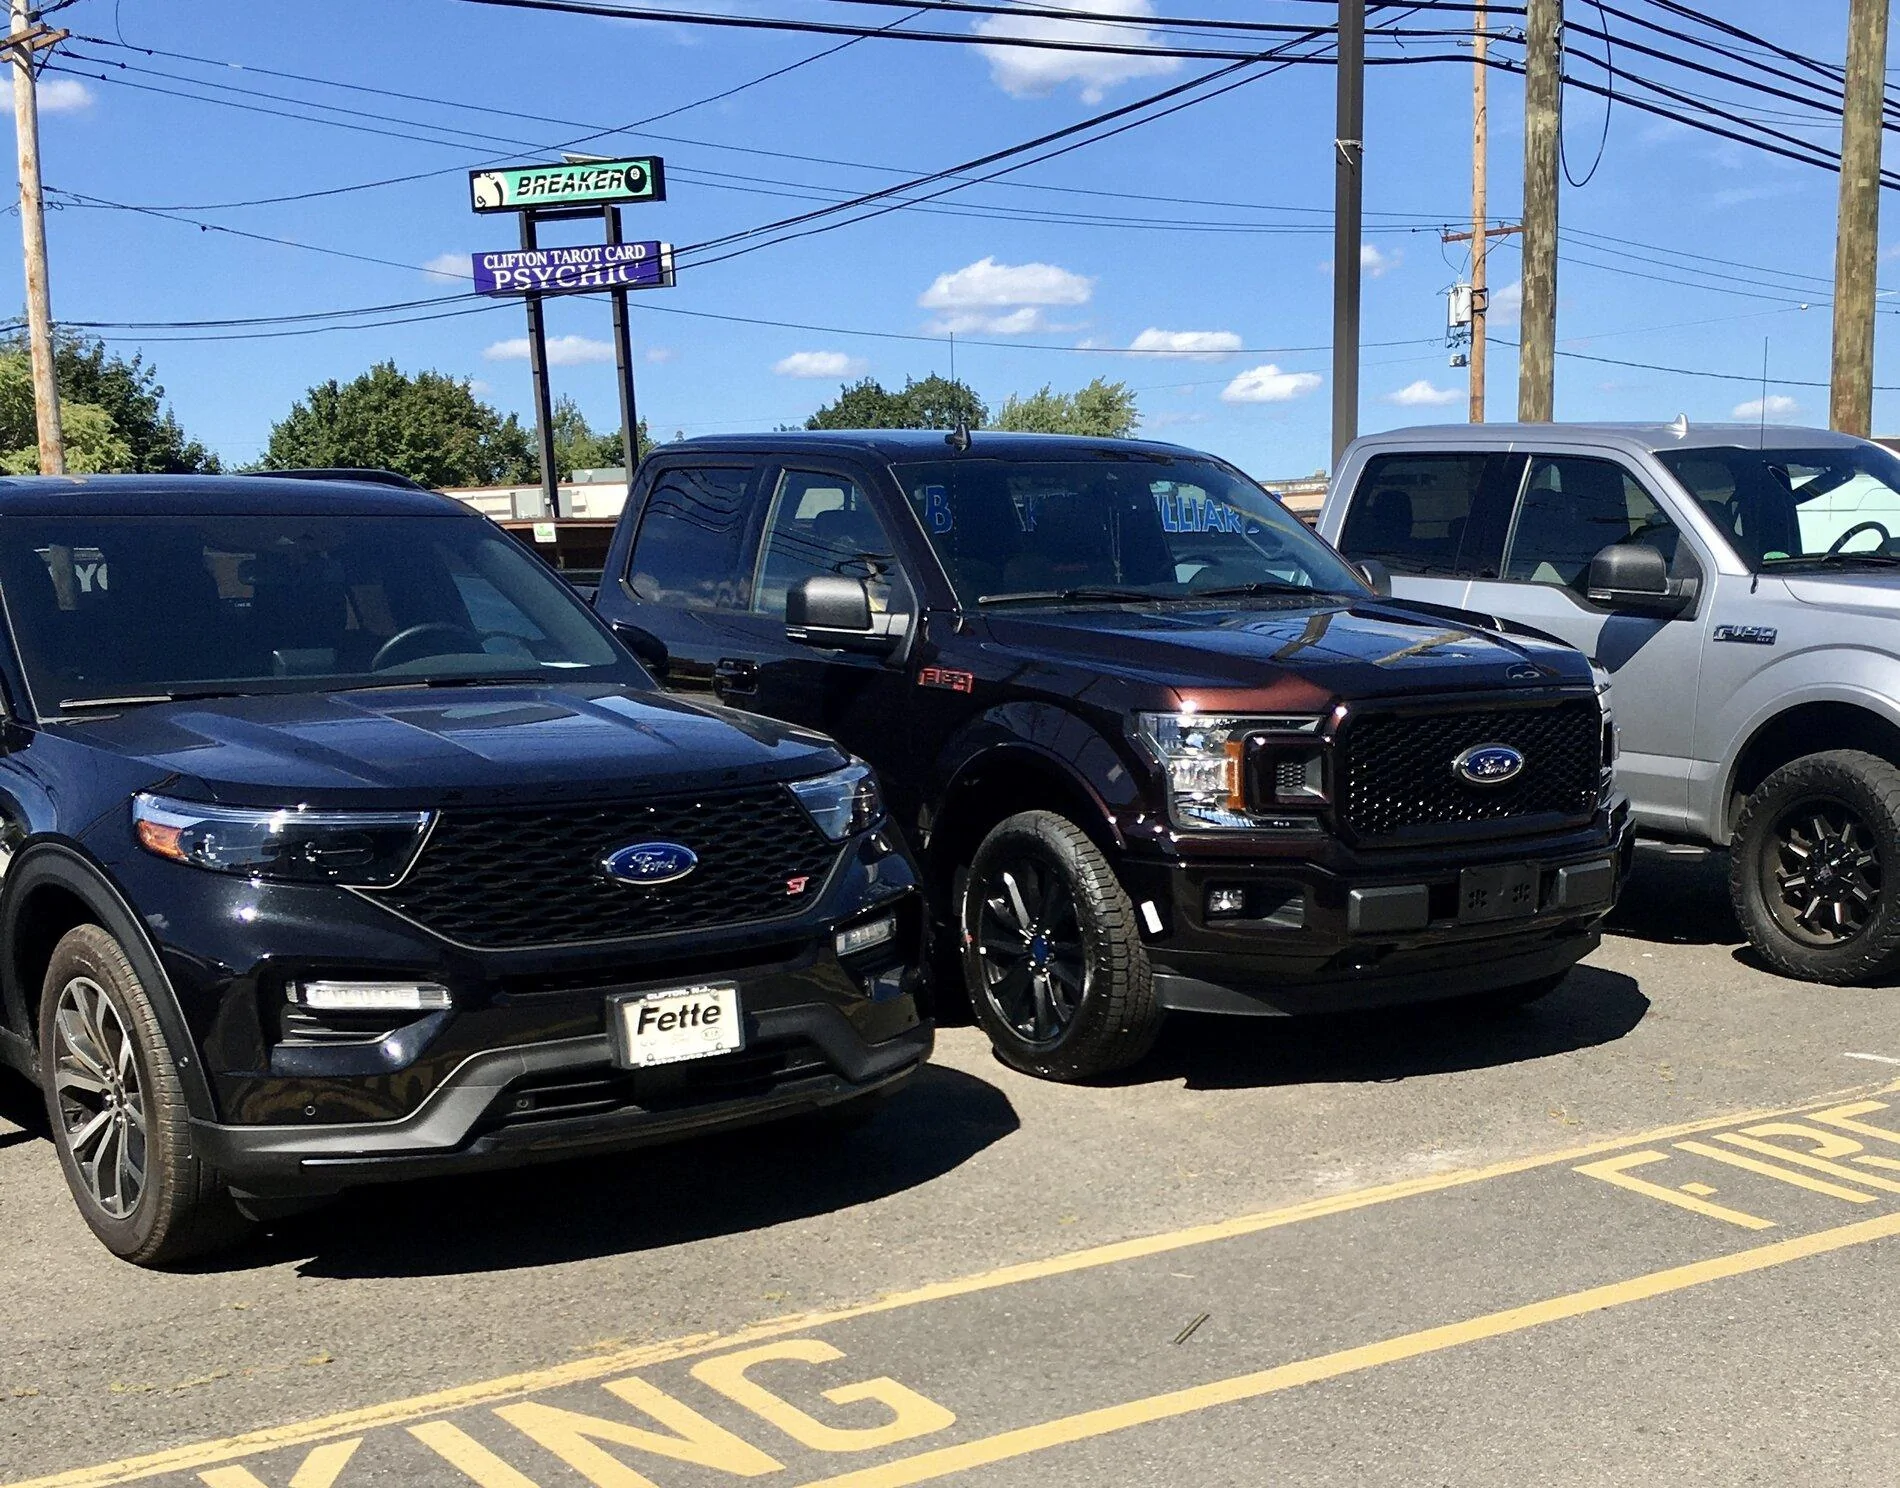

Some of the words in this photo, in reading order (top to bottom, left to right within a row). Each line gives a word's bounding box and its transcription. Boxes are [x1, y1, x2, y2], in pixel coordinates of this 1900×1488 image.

[517, 169, 623, 196] BREAKER
[483, 251, 547, 270] CLIFTON
[550, 248, 602, 265] TAROT
[604, 244, 646, 261] CARD
[492, 262, 640, 291] PSYCHIC
[637, 1003, 722, 1035] Fette
